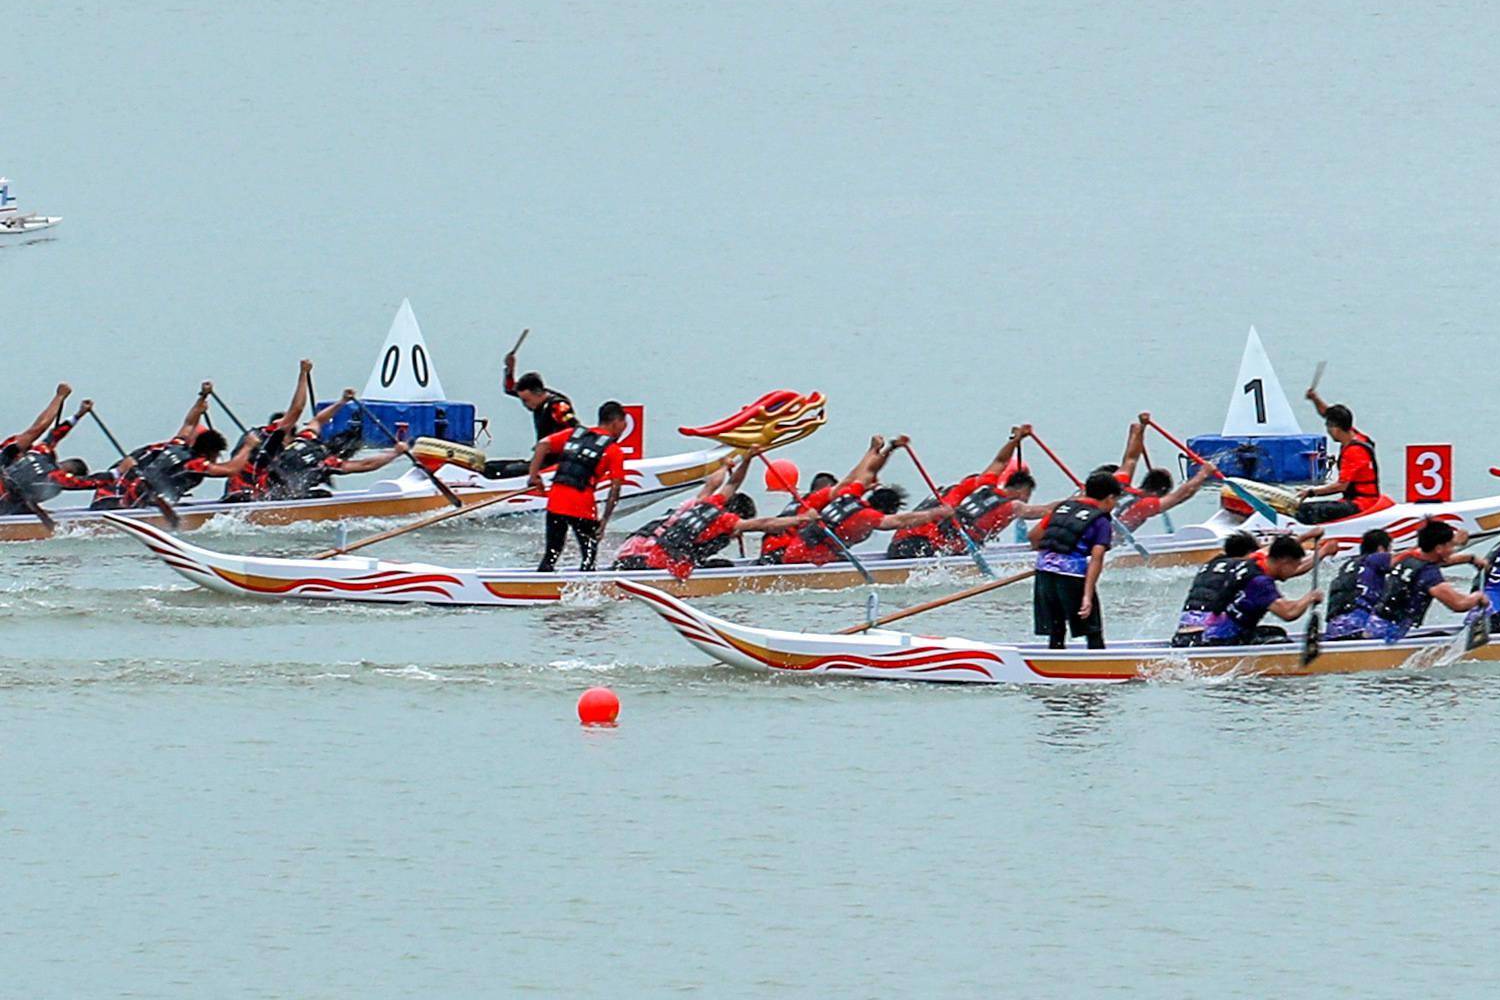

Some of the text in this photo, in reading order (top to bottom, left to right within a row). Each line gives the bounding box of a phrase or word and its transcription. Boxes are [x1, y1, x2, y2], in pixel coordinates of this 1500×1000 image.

[381, 345, 399, 387] 0
[412, 344, 428, 387] 0
[1244, 378, 1267, 424] 1
[1414, 451, 1443, 496] 3
